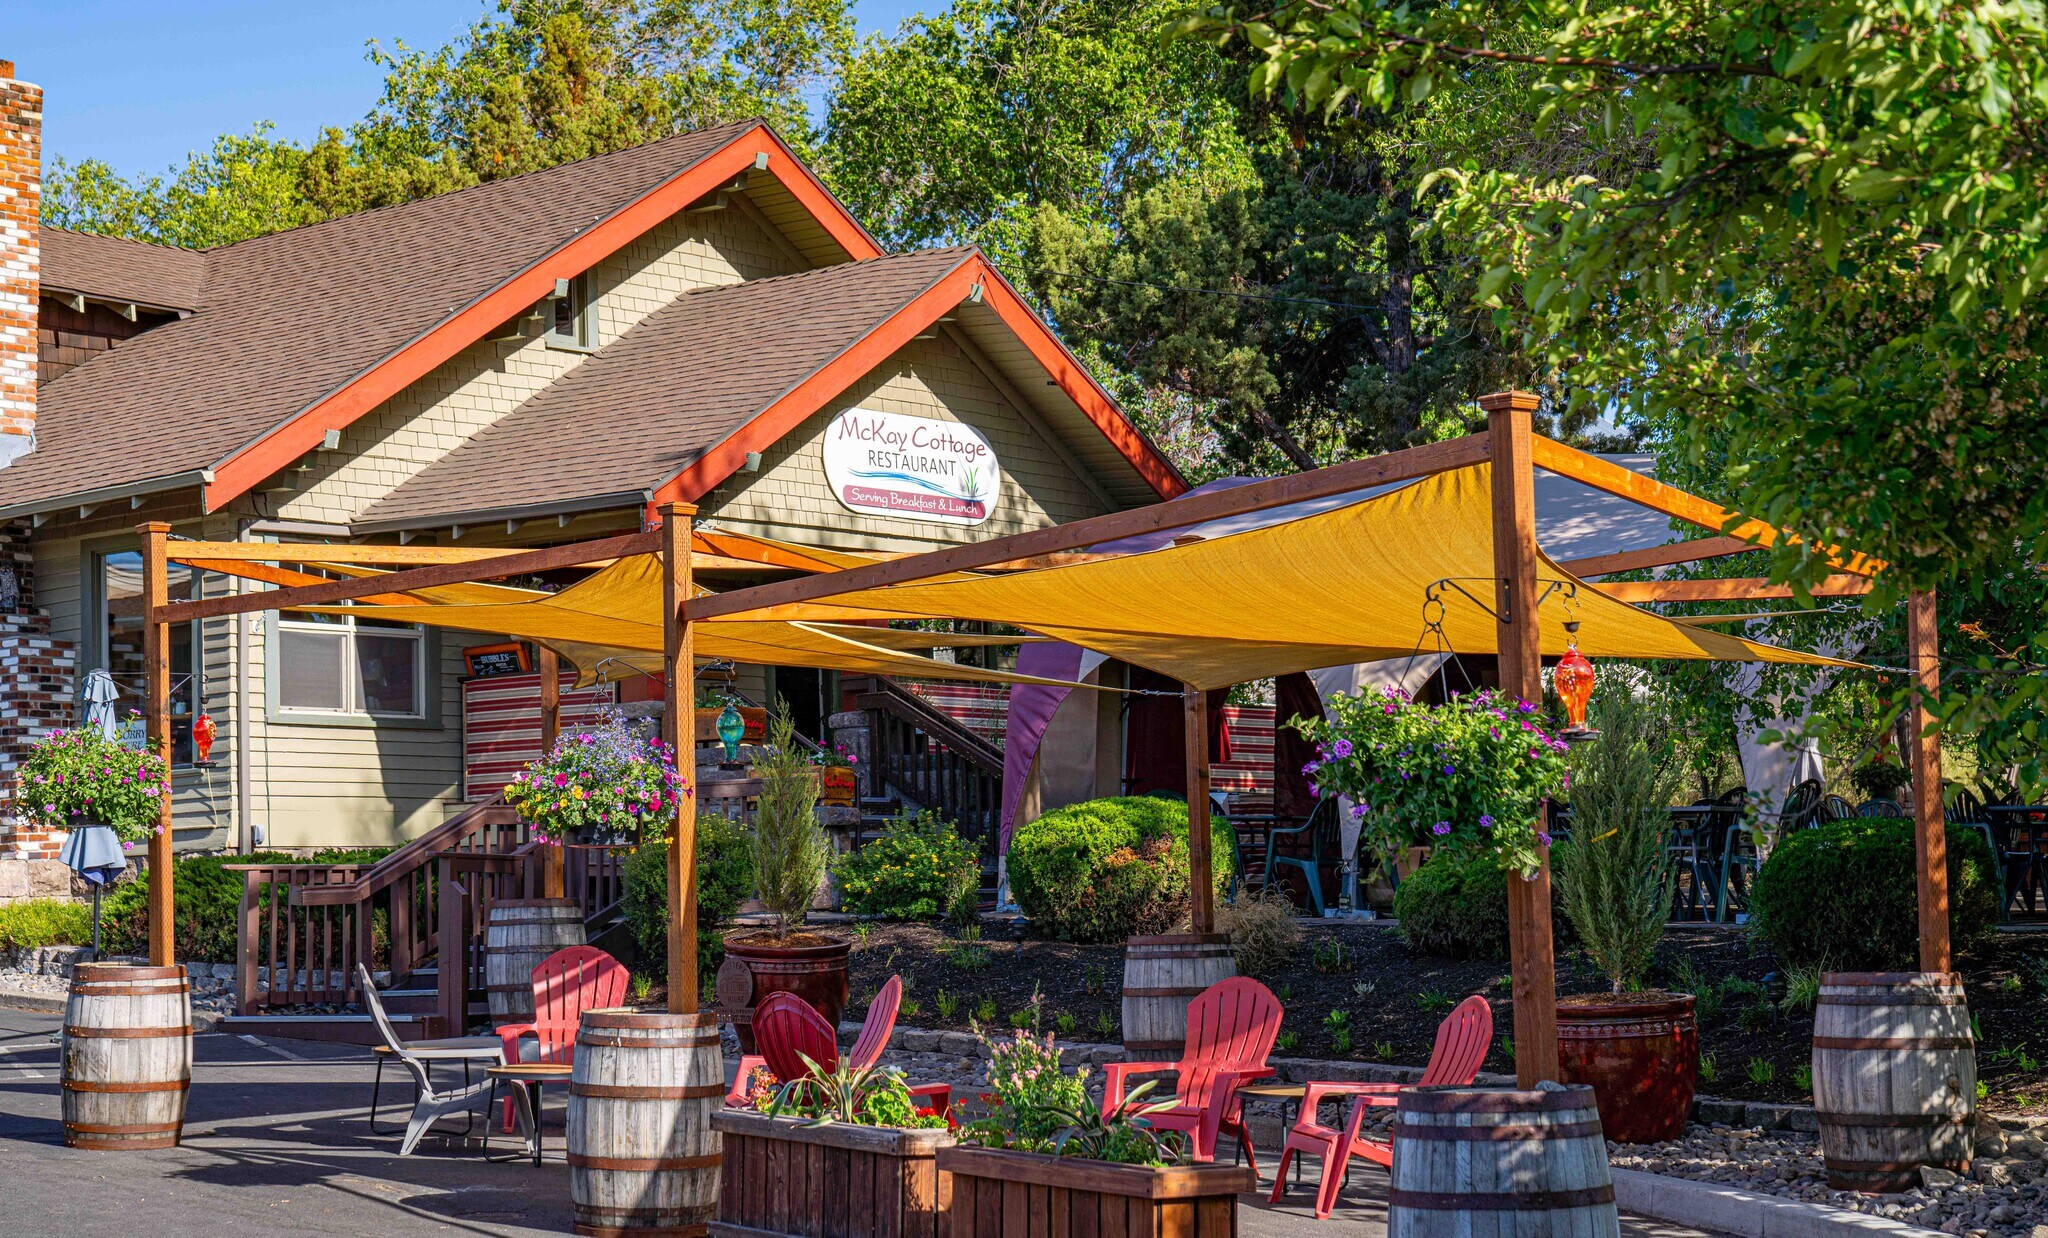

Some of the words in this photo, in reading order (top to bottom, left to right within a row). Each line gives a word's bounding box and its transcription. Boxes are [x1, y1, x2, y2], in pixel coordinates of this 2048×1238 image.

[838, 414, 908, 452] McKay
[912, 425, 987, 462] Cottage
[868, 449, 957, 477] RESTAURANT
[851, 487, 889, 507] Serving
[889, 492, 937, 512] Breakfast
[938, 500, 946, 510] &
[948, 500, 978, 515] Lunch
